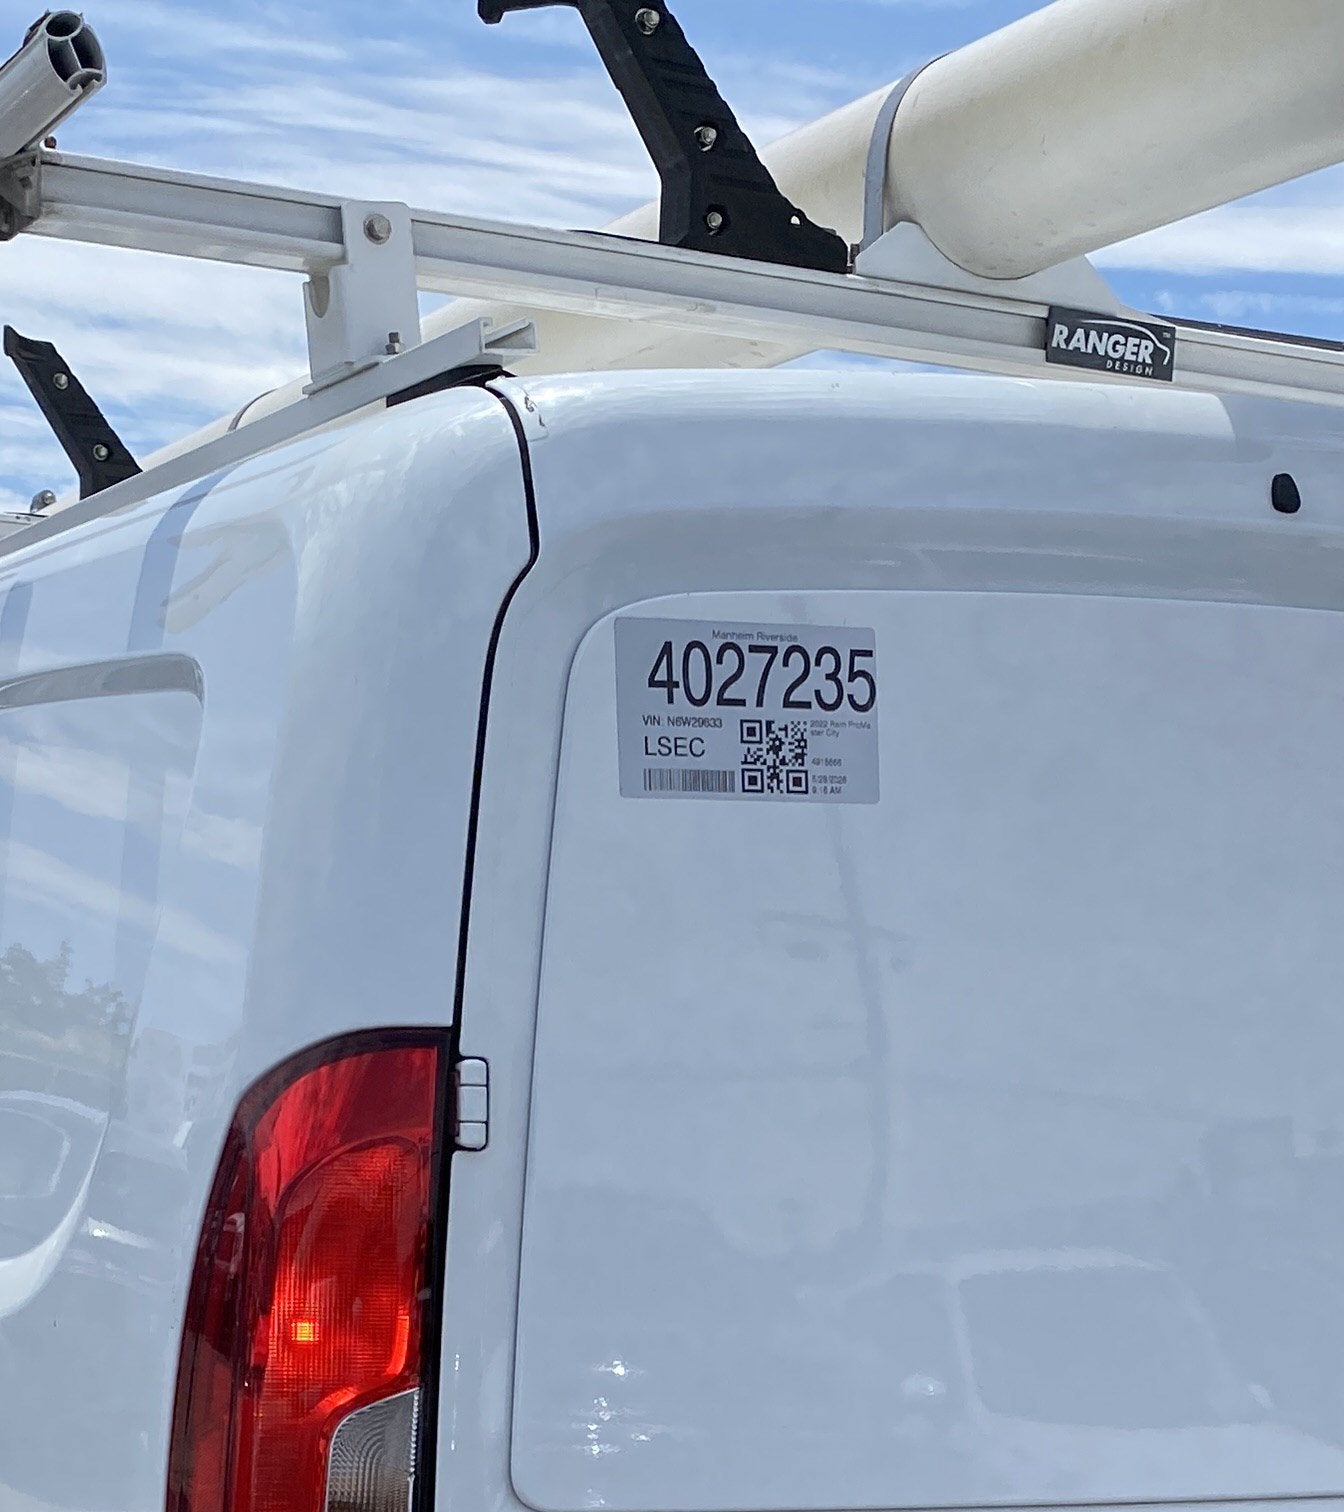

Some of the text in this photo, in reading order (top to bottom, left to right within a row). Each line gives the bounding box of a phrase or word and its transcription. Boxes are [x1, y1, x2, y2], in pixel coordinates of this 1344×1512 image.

[1051, 323, 1155, 364] RANGER
[1106, 359, 1154, 376] DESIGN
[712, 629, 799, 643] Manheim Riverside
[647, 640, 877, 713] 4027235
[644, 735, 706, 758] LSEC
